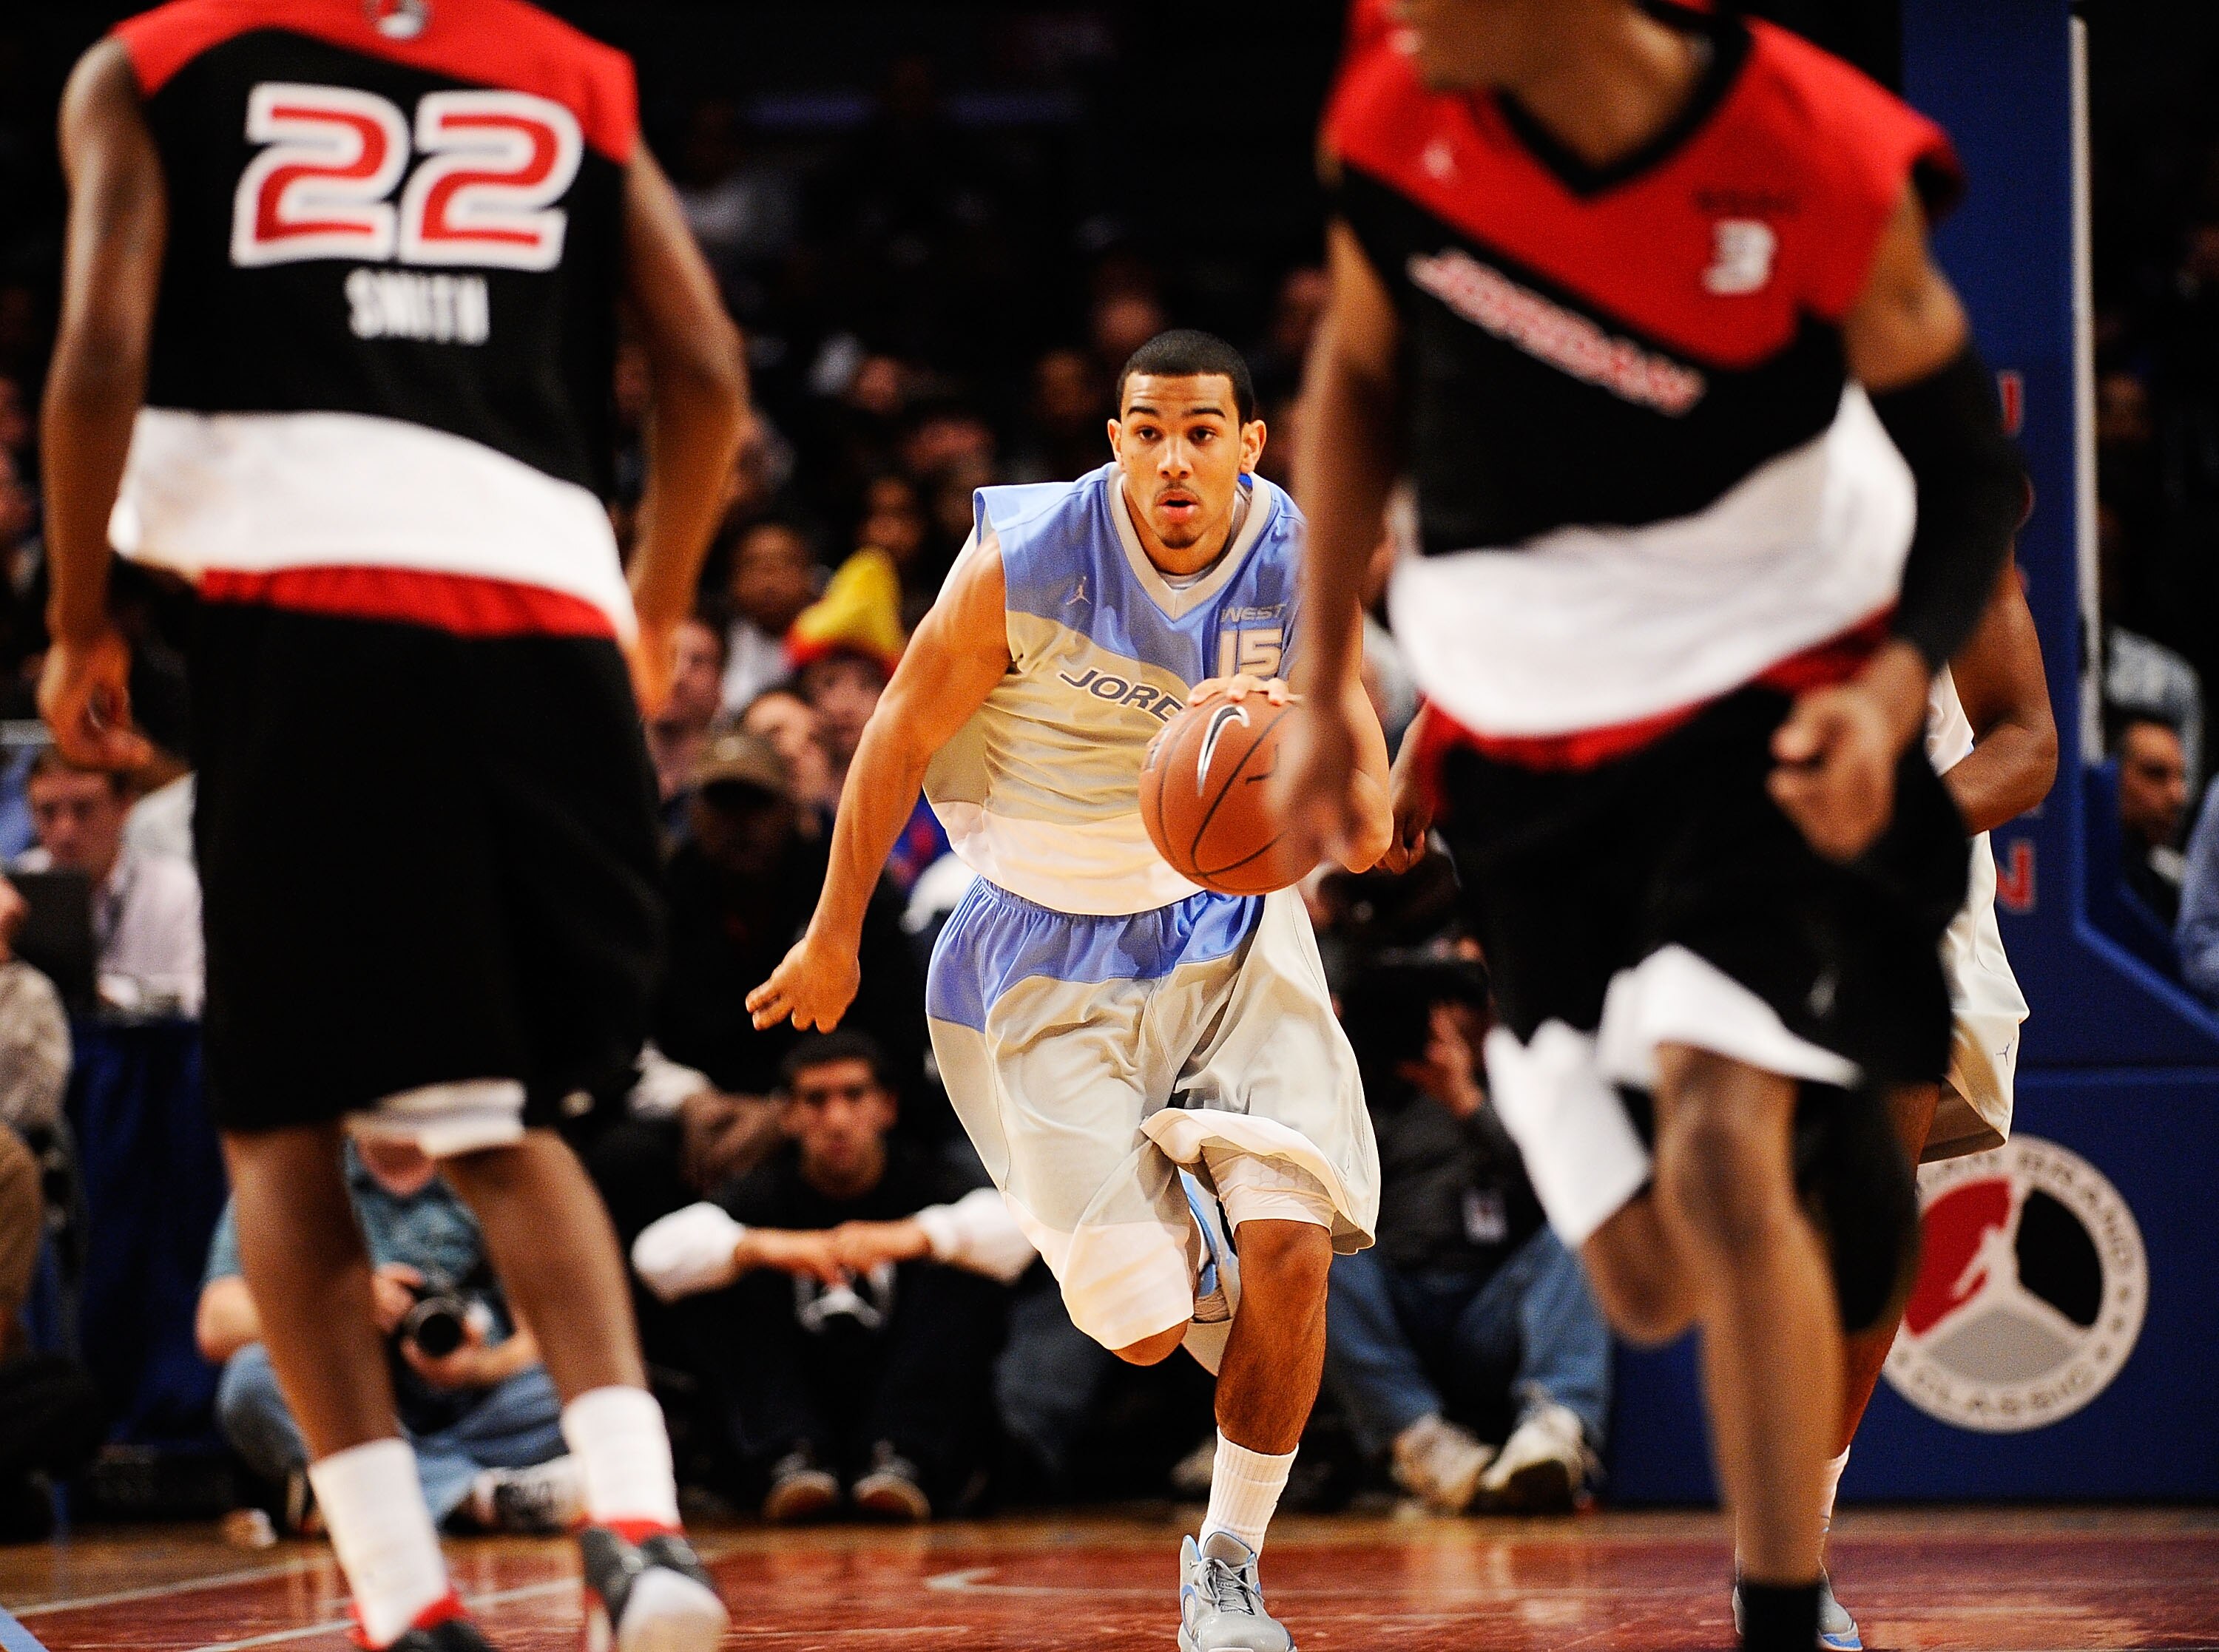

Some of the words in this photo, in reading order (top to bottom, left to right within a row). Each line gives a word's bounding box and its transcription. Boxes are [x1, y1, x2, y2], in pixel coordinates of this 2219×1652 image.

[230, 81, 584, 272] 22
[1703, 217, 1777, 294] 3
[1220, 603, 1287, 623] WEST
[1218, 628, 1283, 678] 15
[1058, 666, 1186, 724] JORD
[1911, 1359, 2095, 1415] CLASSIC
